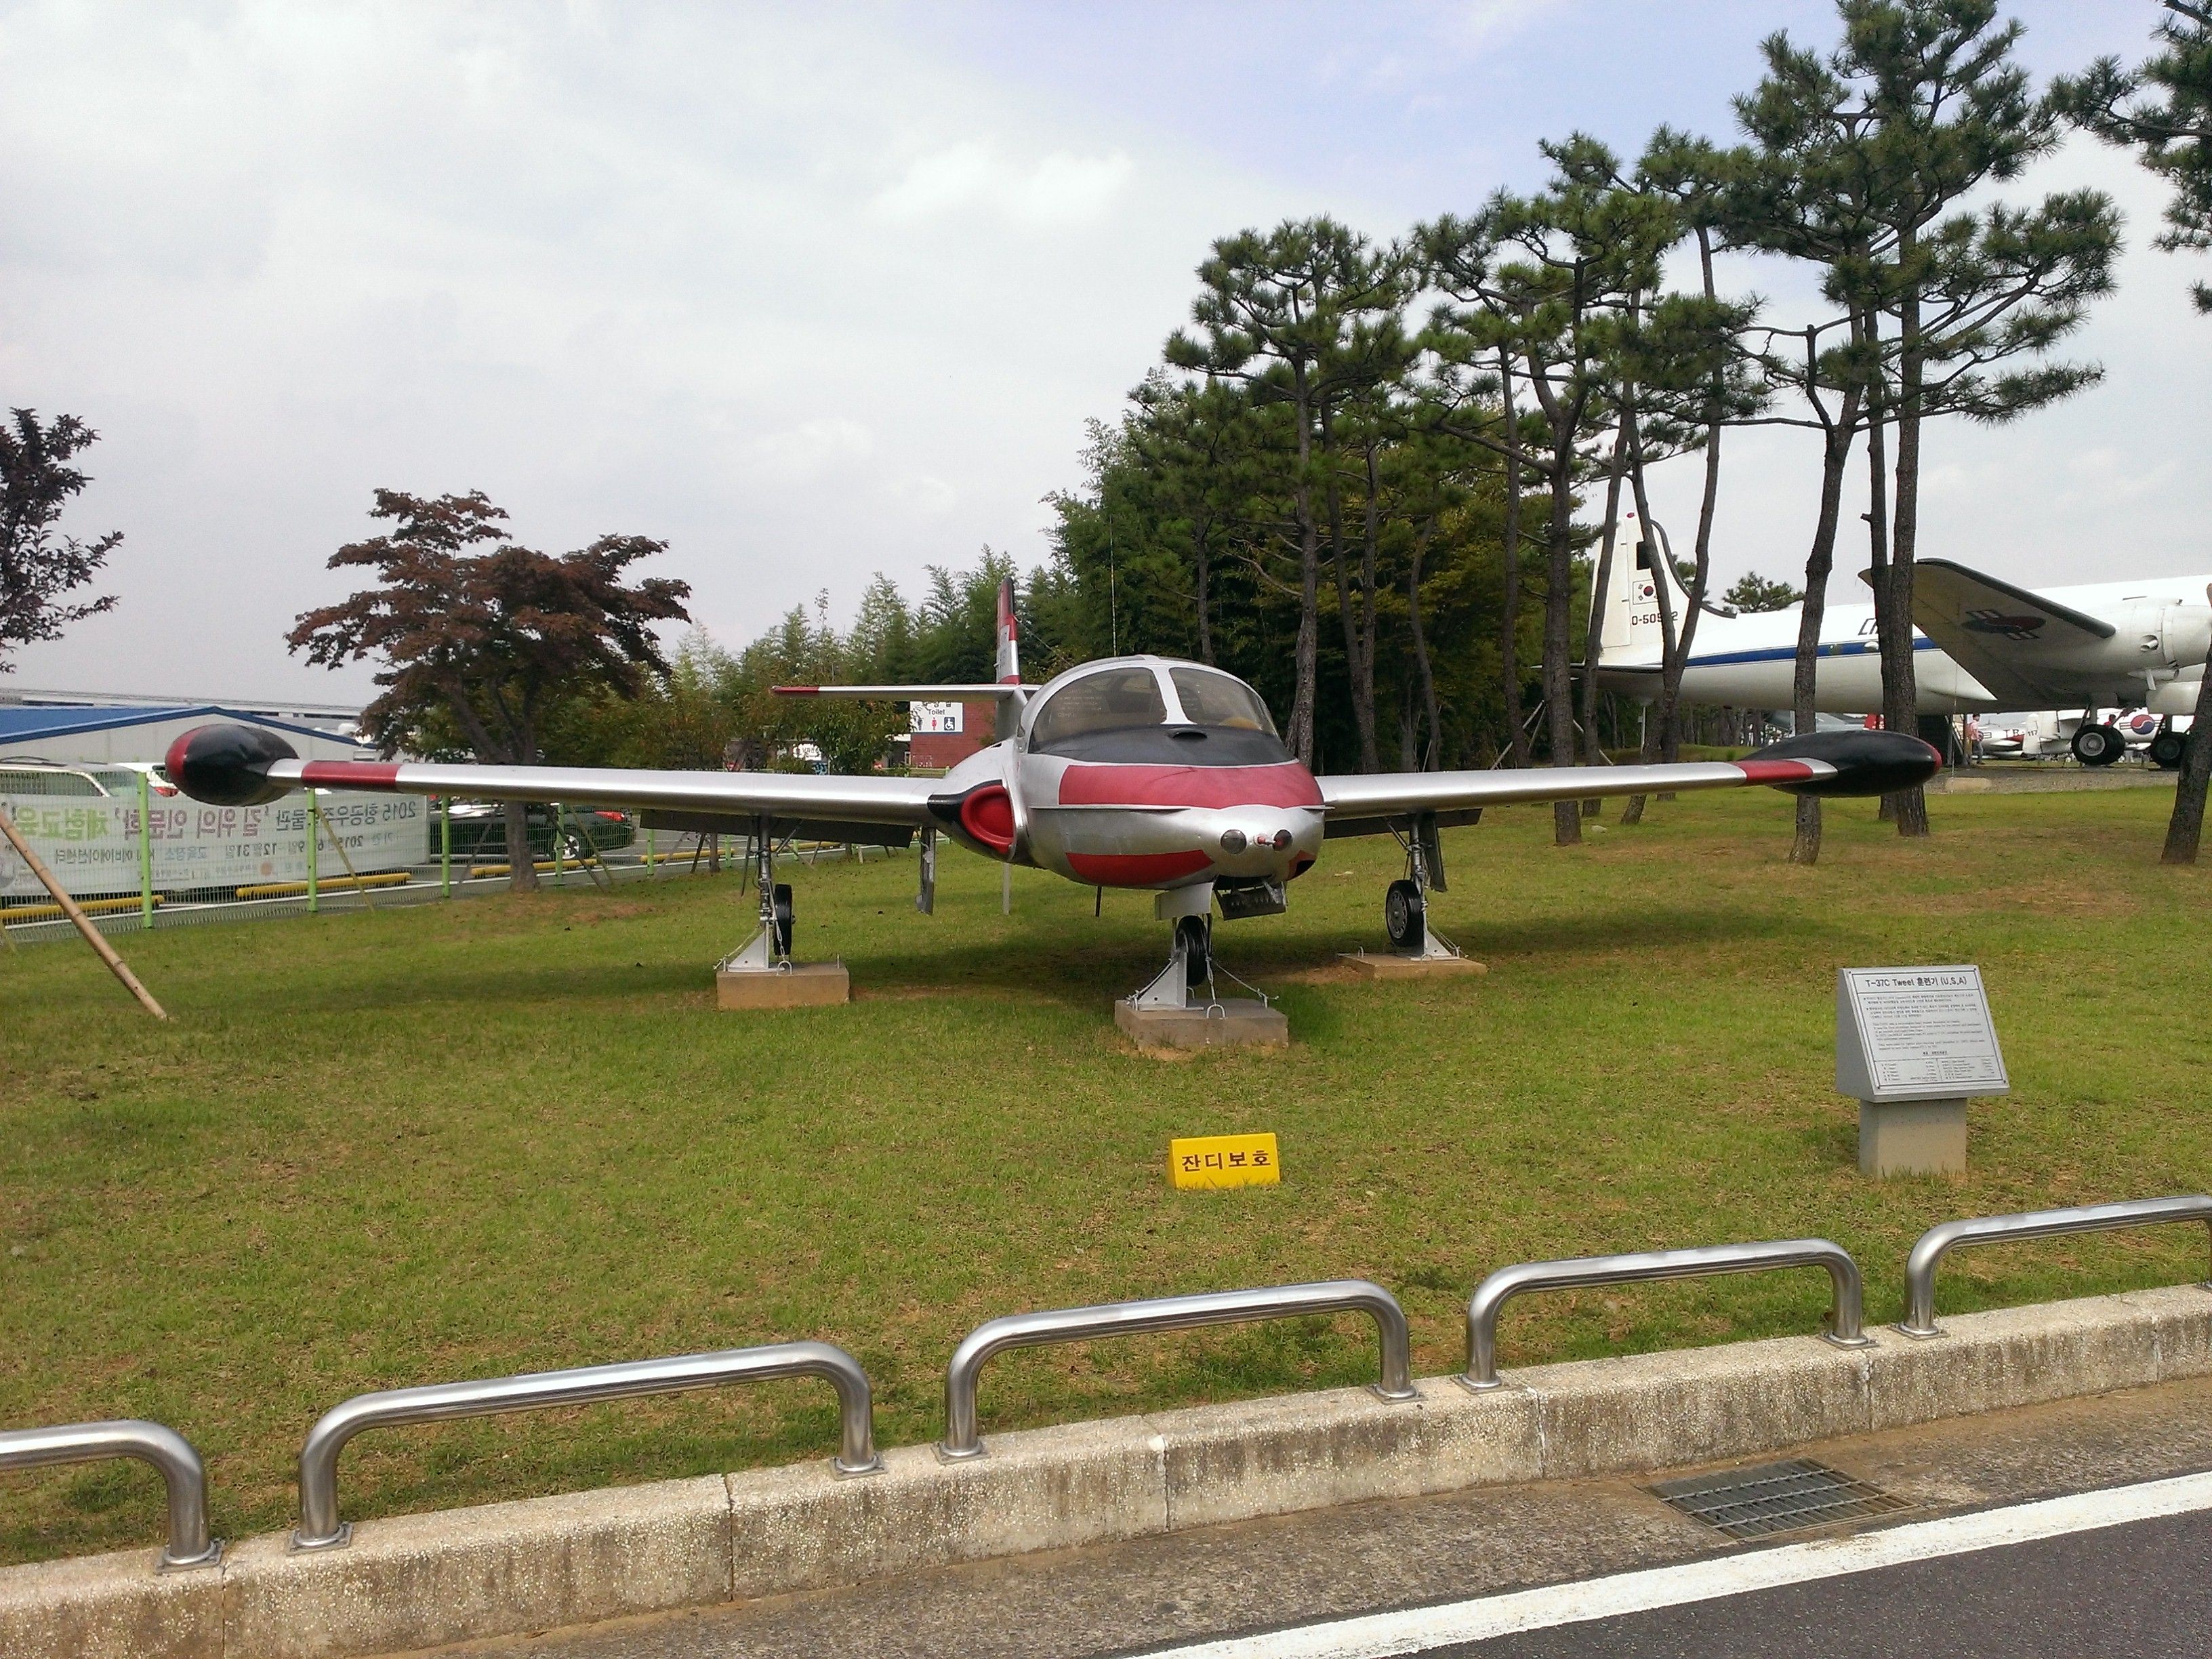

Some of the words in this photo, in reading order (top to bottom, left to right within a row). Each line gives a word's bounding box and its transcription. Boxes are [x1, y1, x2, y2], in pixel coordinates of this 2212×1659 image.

[1631, 611, 1679, 626] 0-5052
[1865, 979, 1890, 987] T-37C
[1892, 978, 1914, 987] Tweet
[1917, 977, 1939, 986] 훈련기
[1940, 976, 1967, 986] (U.S.A)
[1181, 1149, 1271, 1172] 잔디보호
